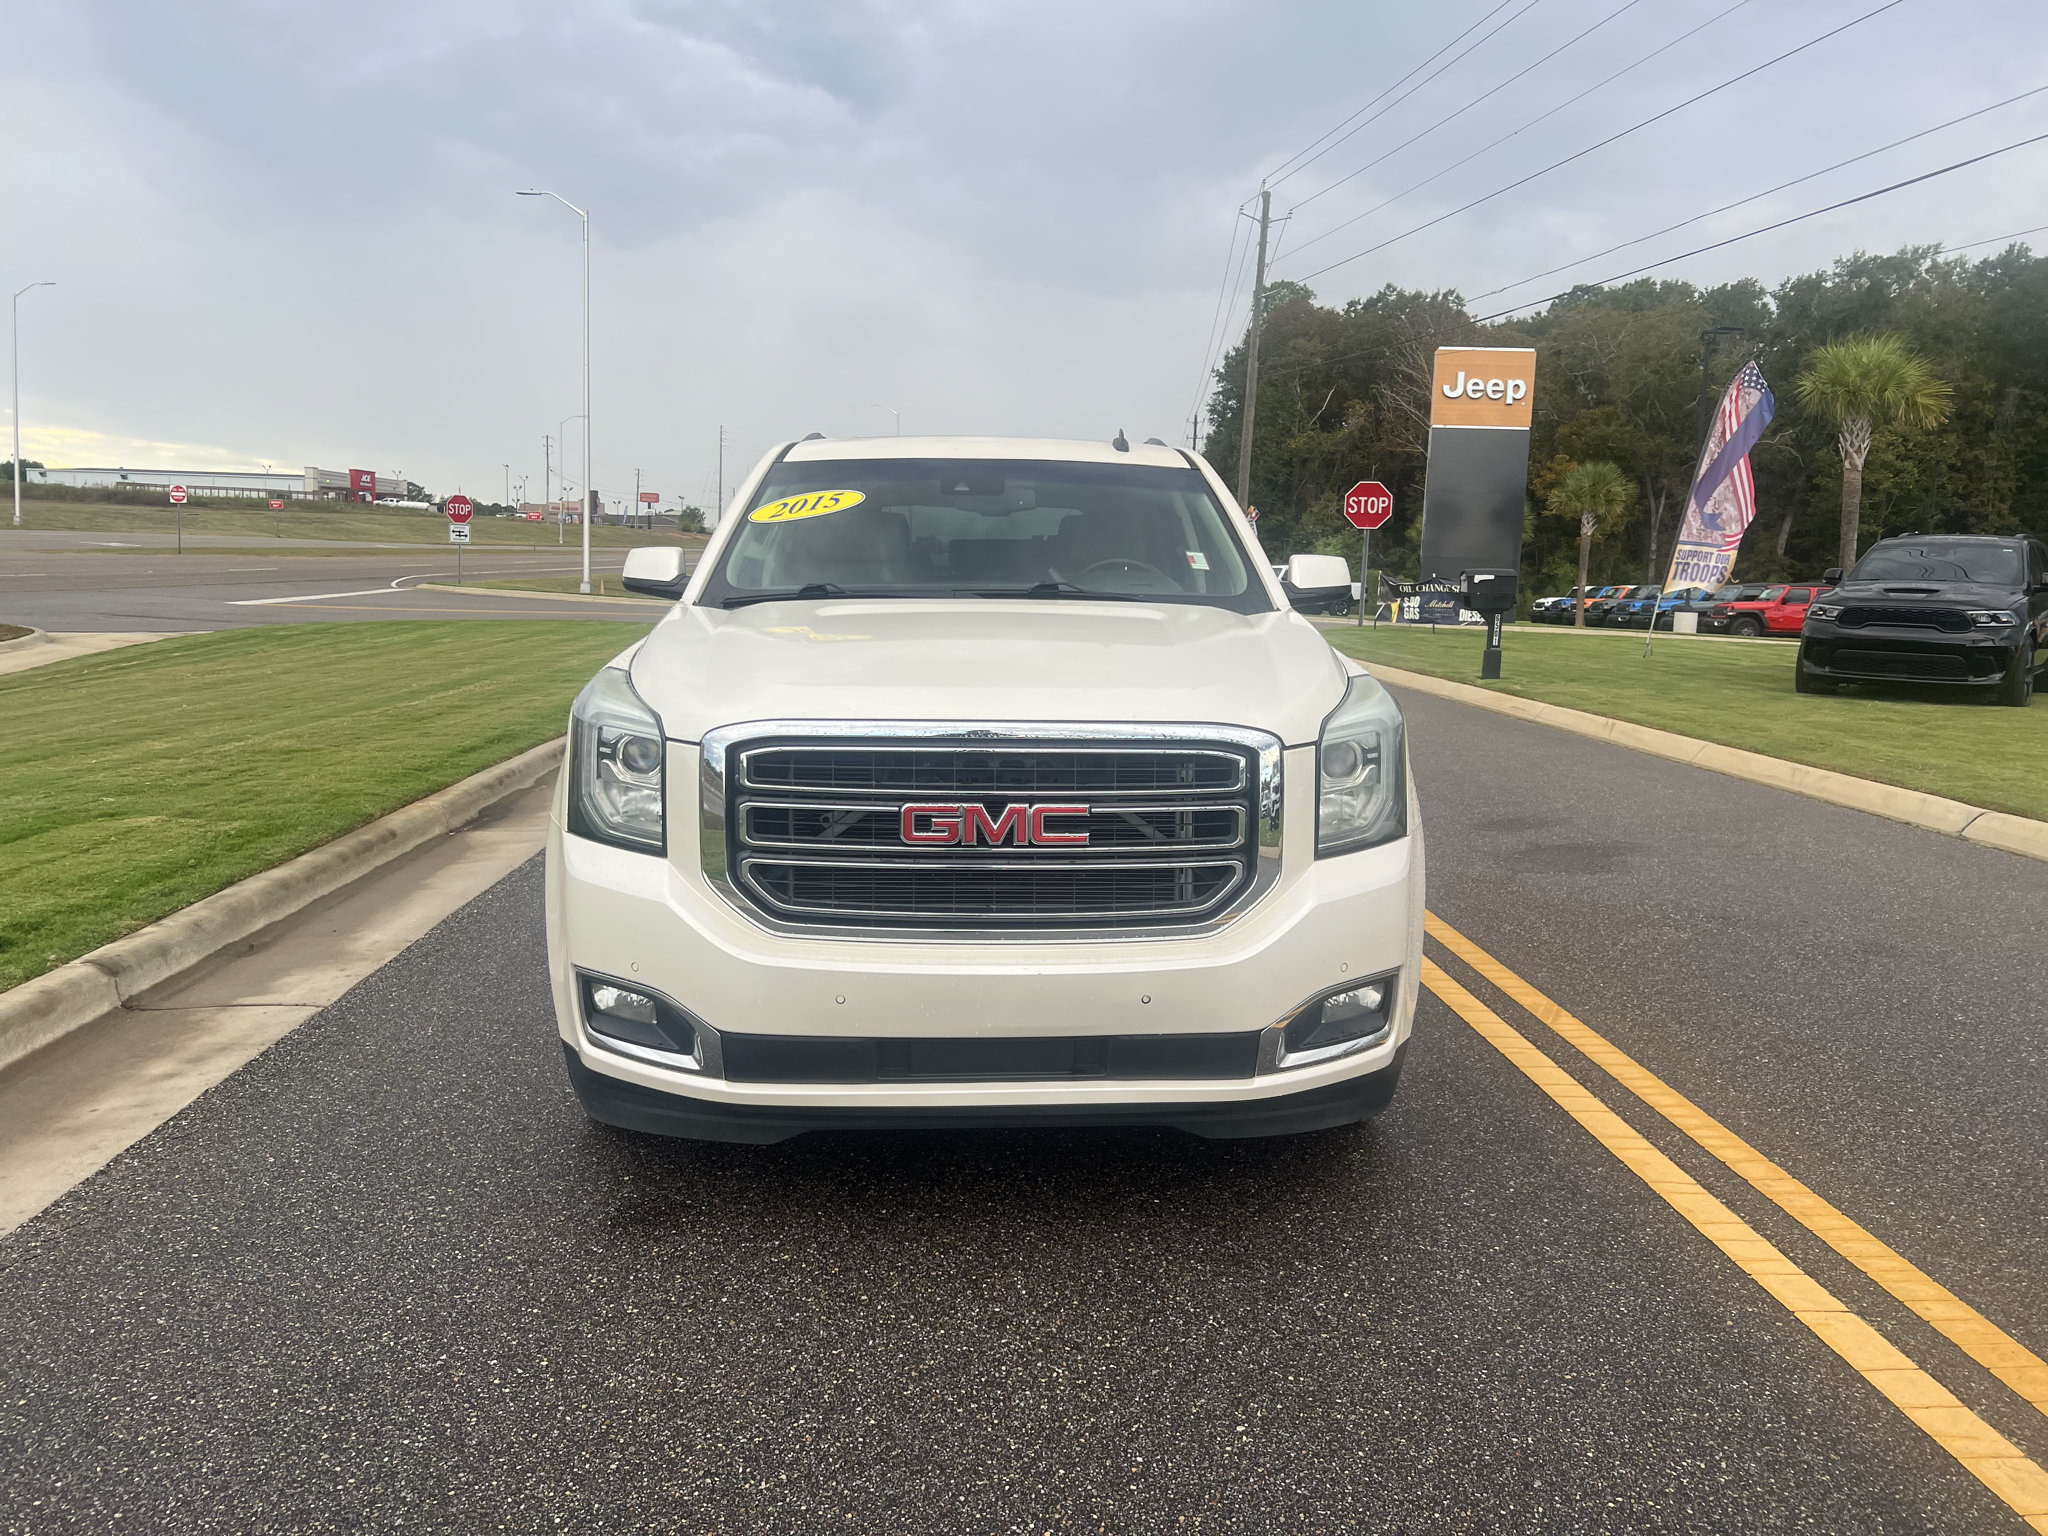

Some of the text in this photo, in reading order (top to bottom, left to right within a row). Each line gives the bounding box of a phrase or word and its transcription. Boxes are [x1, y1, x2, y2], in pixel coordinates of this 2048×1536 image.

[1442, 371, 1527, 405] Jeep
[448, 503, 471, 515] STOP
[768, 492, 845, 519] 2015
[1348, 497, 1389, 514] STOP
[1676, 549, 1731, 565] SUPPORT OUR
[1672, 561, 1728, 584] TROOPS
[1399, 584, 1415, 593] OIL
[1416, 583, 1452, 593] CHANGE
[1403, 595, 1421, 608] $40
[1424, 599, 1455, 608] Mitchell
[1403, 607, 1420, 620] GAS
[1459, 608, 1486, 622] DIESE
[900, 803, 1090, 846] GMC
